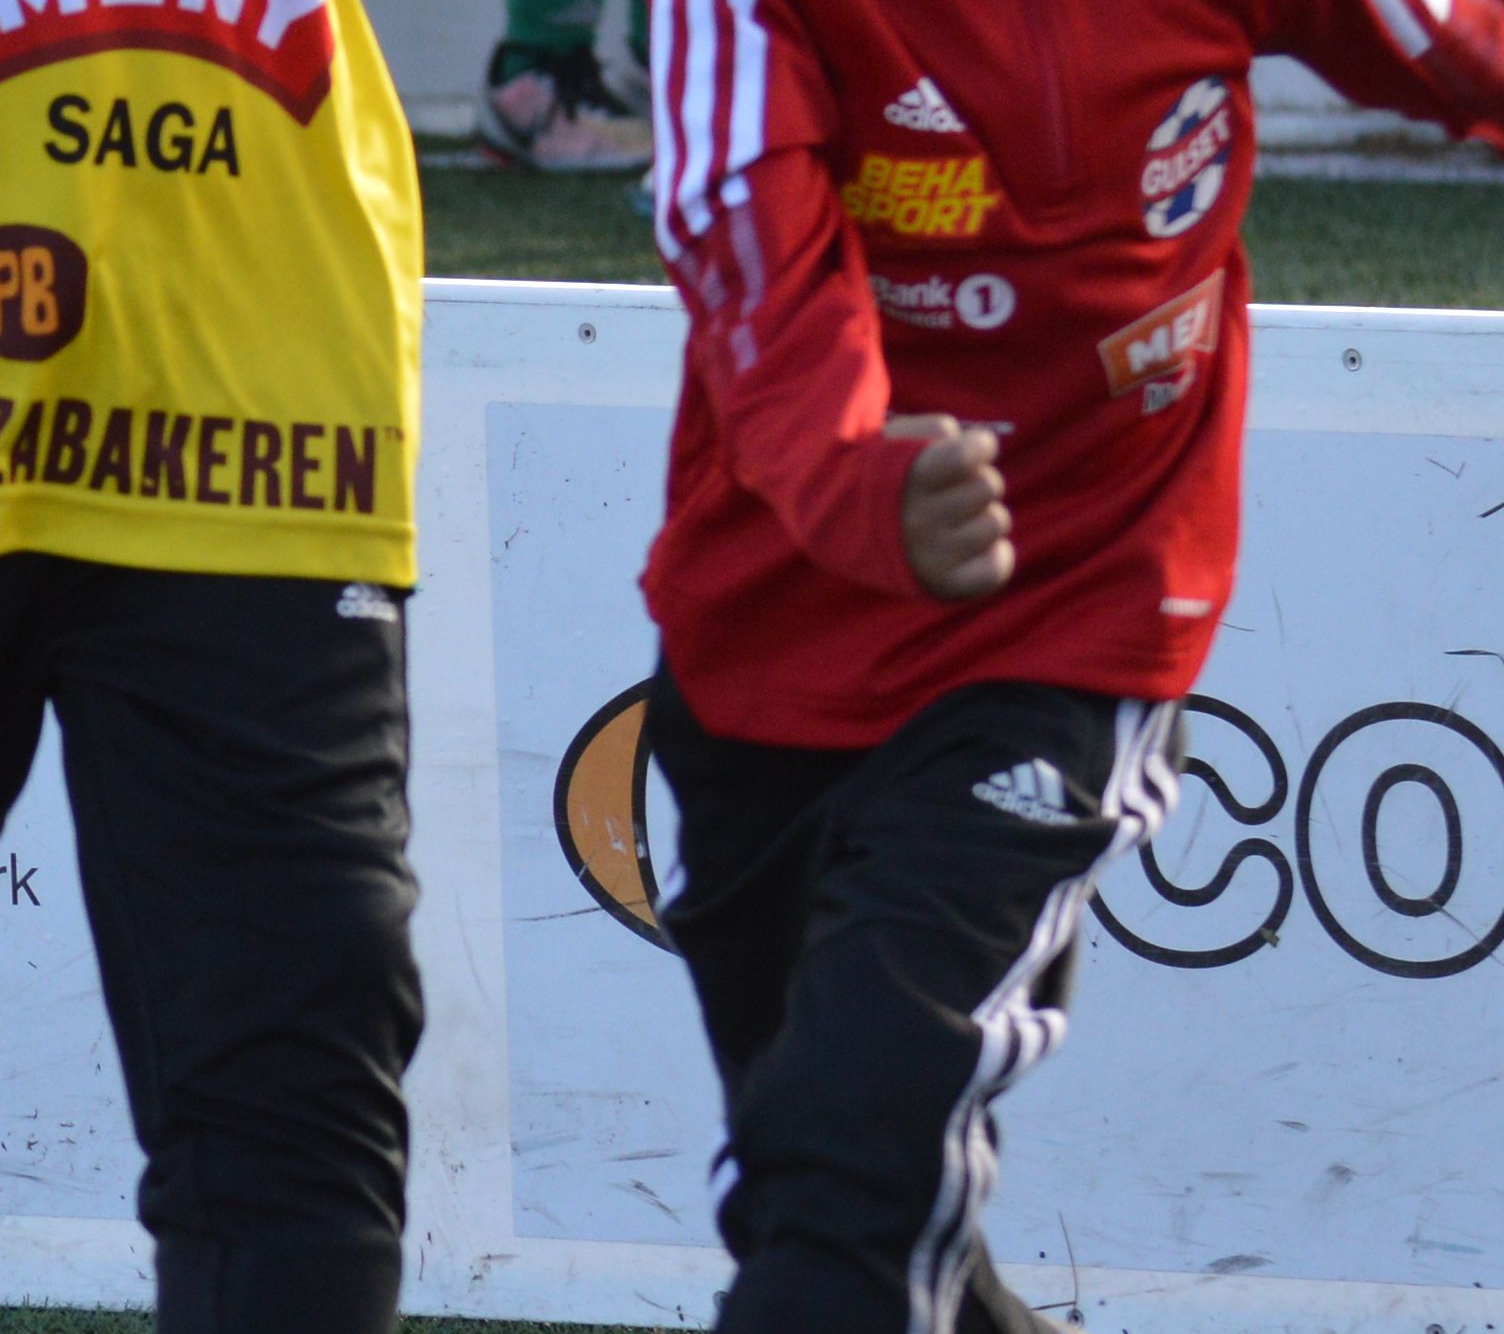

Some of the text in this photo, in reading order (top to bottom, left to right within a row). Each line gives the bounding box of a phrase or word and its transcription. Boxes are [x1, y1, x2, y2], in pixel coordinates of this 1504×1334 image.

[43, 93, 240, 177] SAGA
[859, 154, 985, 197] BEHA
[842, 183, 999, 234] SPORT
